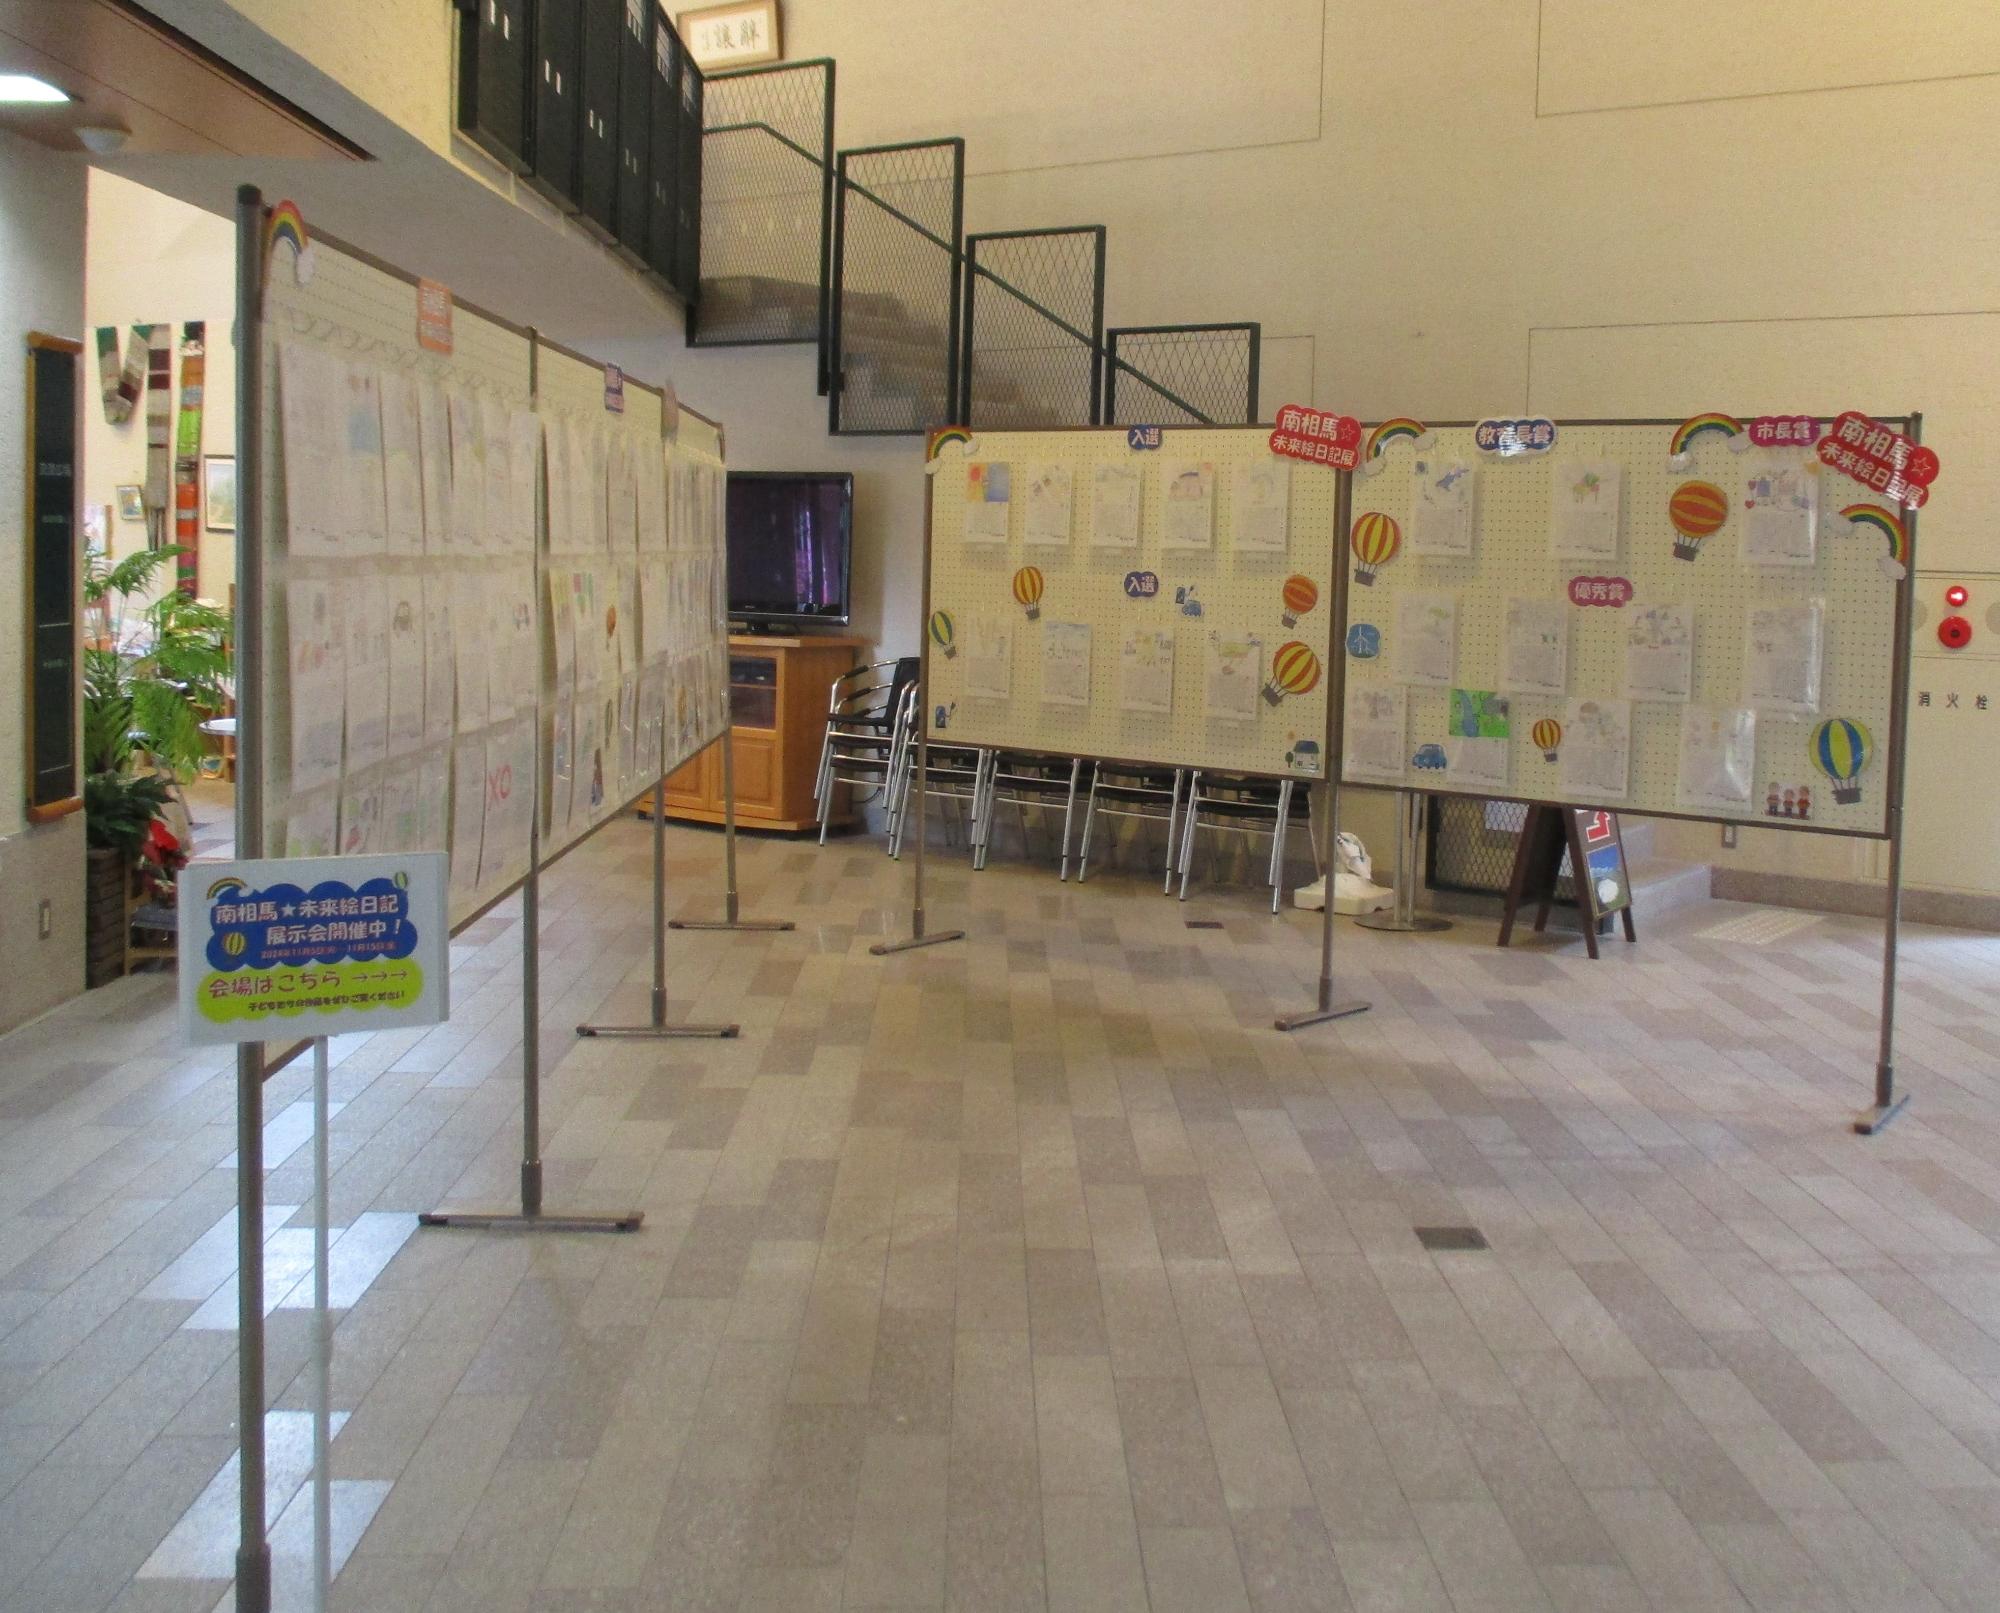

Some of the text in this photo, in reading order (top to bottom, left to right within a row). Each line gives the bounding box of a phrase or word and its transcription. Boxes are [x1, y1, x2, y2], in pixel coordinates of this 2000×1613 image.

[1131, 428, 1159, 446] 入選
[1281, 409, 1340, 441] 南相馬
[1757, 420, 1811, 440] 市長賞
[1273, 434, 1355, 467] 未来絵日記展
[1837, 415, 1915, 470] 南相馬
[1821, 441, 1924, 505] 未来絵日記展
[1127, 575, 1155, 593] 入選
[1574, 581, 1625, 601] 優秀賞
[1918, 690, 1988, 710] 消火栓
[208, 970, 342, 998] 会場はこちら
